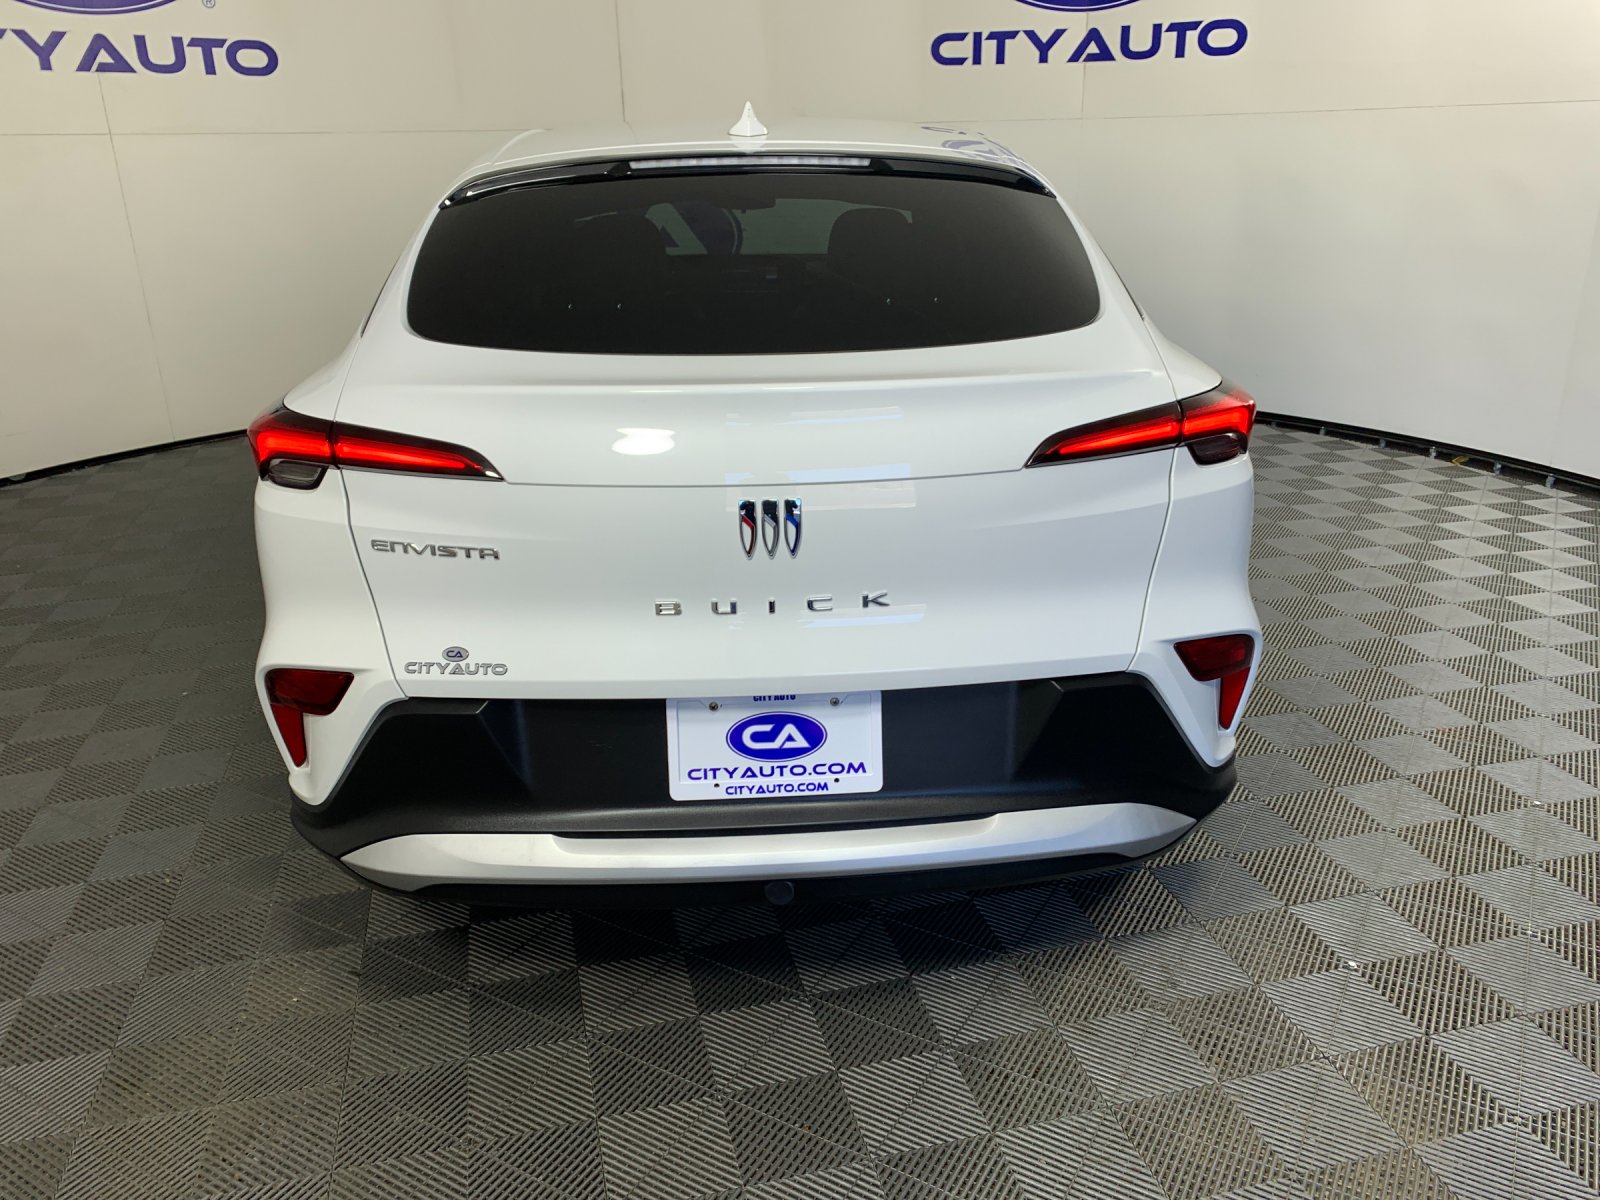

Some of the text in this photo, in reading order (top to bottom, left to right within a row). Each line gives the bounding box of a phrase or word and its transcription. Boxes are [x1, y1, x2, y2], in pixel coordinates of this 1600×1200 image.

[370, 539, 500, 560] ENVISTA
[654, 591, 890, 615] BUICK
[742, 723, 812, 749] CA
[687, 762, 867, 781] CITYAUTO.COM
[725, 782, 829, 796] CITYAUTO.COM
